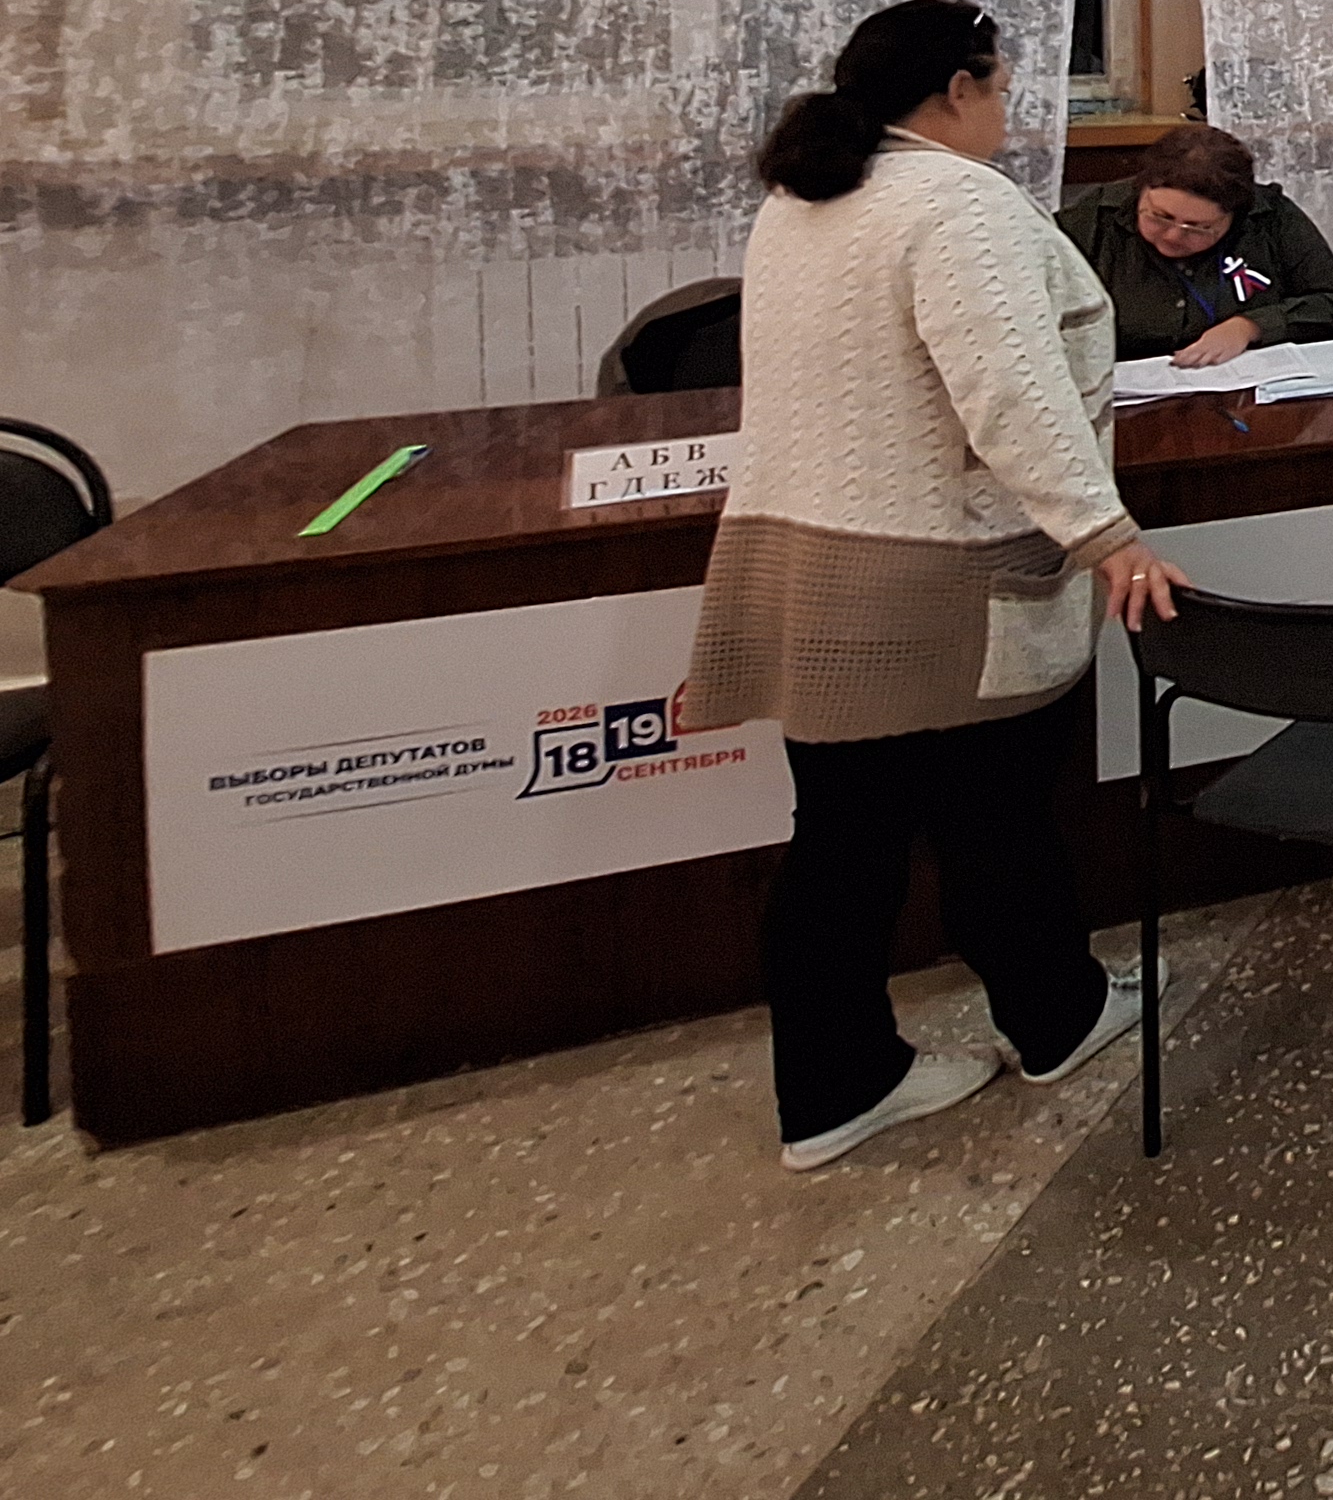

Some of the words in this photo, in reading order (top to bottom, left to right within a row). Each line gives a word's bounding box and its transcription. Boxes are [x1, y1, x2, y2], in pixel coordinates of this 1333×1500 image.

[610, 452, 633, 471] А
[650, 447, 670, 466] Б
[686, 443, 705, 462] В
[587, 481, 608, 501] Г
[621, 476, 646, 498] Д
[663, 471, 681, 489] Е
[696, 466, 729, 487] Ж
[537, 703, 598, 726] 2026
[609, 712, 664, 750] 19
[209, 760, 328, 791] ВЫБОРЫ
[335, 738, 487, 775] ДЕПУТАТОВ
[545, 741, 598, 778] 18
[616, 747, 747, 782] СЕНТЯБРЯ
[245, 765, 450, 807] ГОСУДАРСТВЕННОЙ
[453, 756, 515, 777] ДУМЫ
